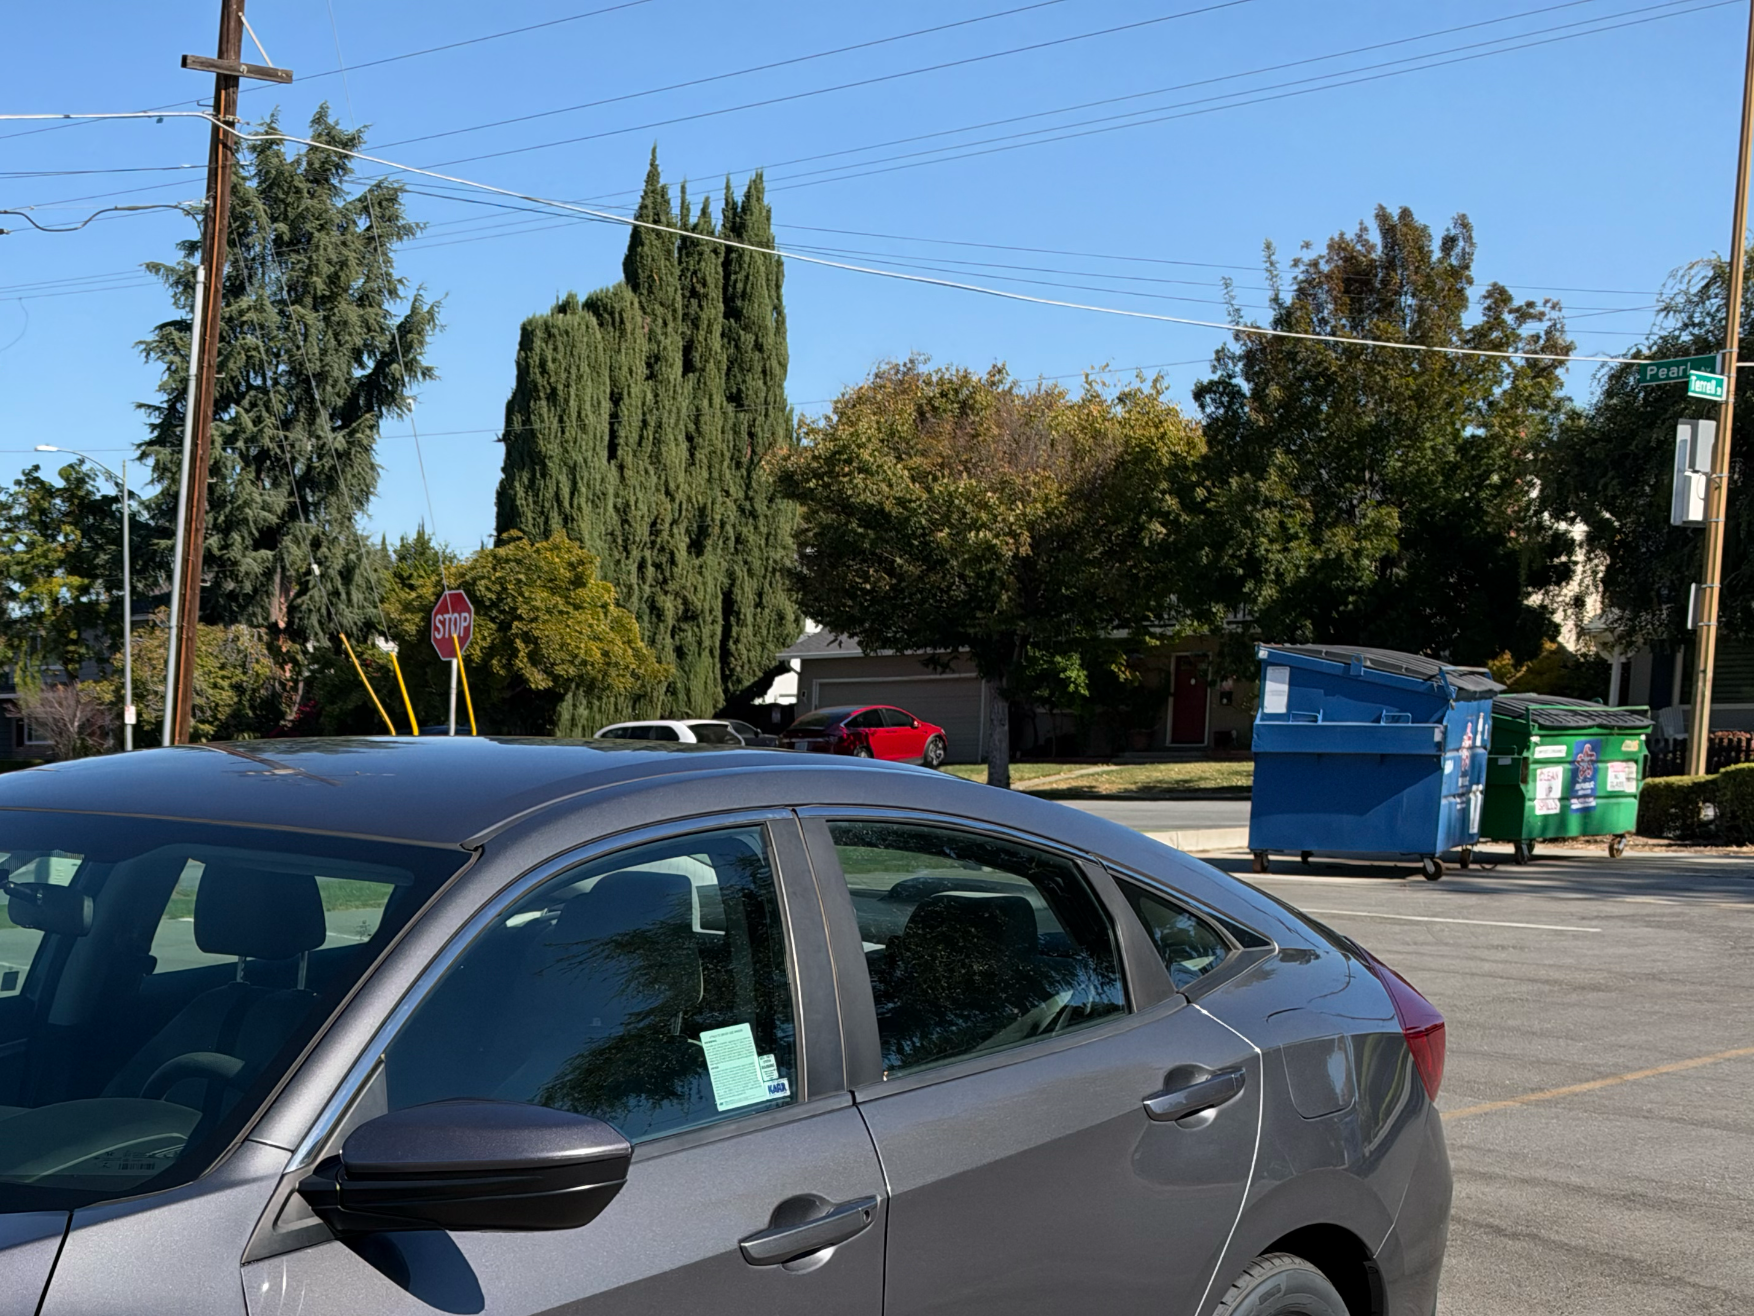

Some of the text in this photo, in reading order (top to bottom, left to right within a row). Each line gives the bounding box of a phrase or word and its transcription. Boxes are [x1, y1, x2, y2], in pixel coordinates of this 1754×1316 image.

[1646, 361, 1690, 380] Pearl
[1690, 375, 1717, 395] Terrell
[434, 612, 470, 639] STOP
